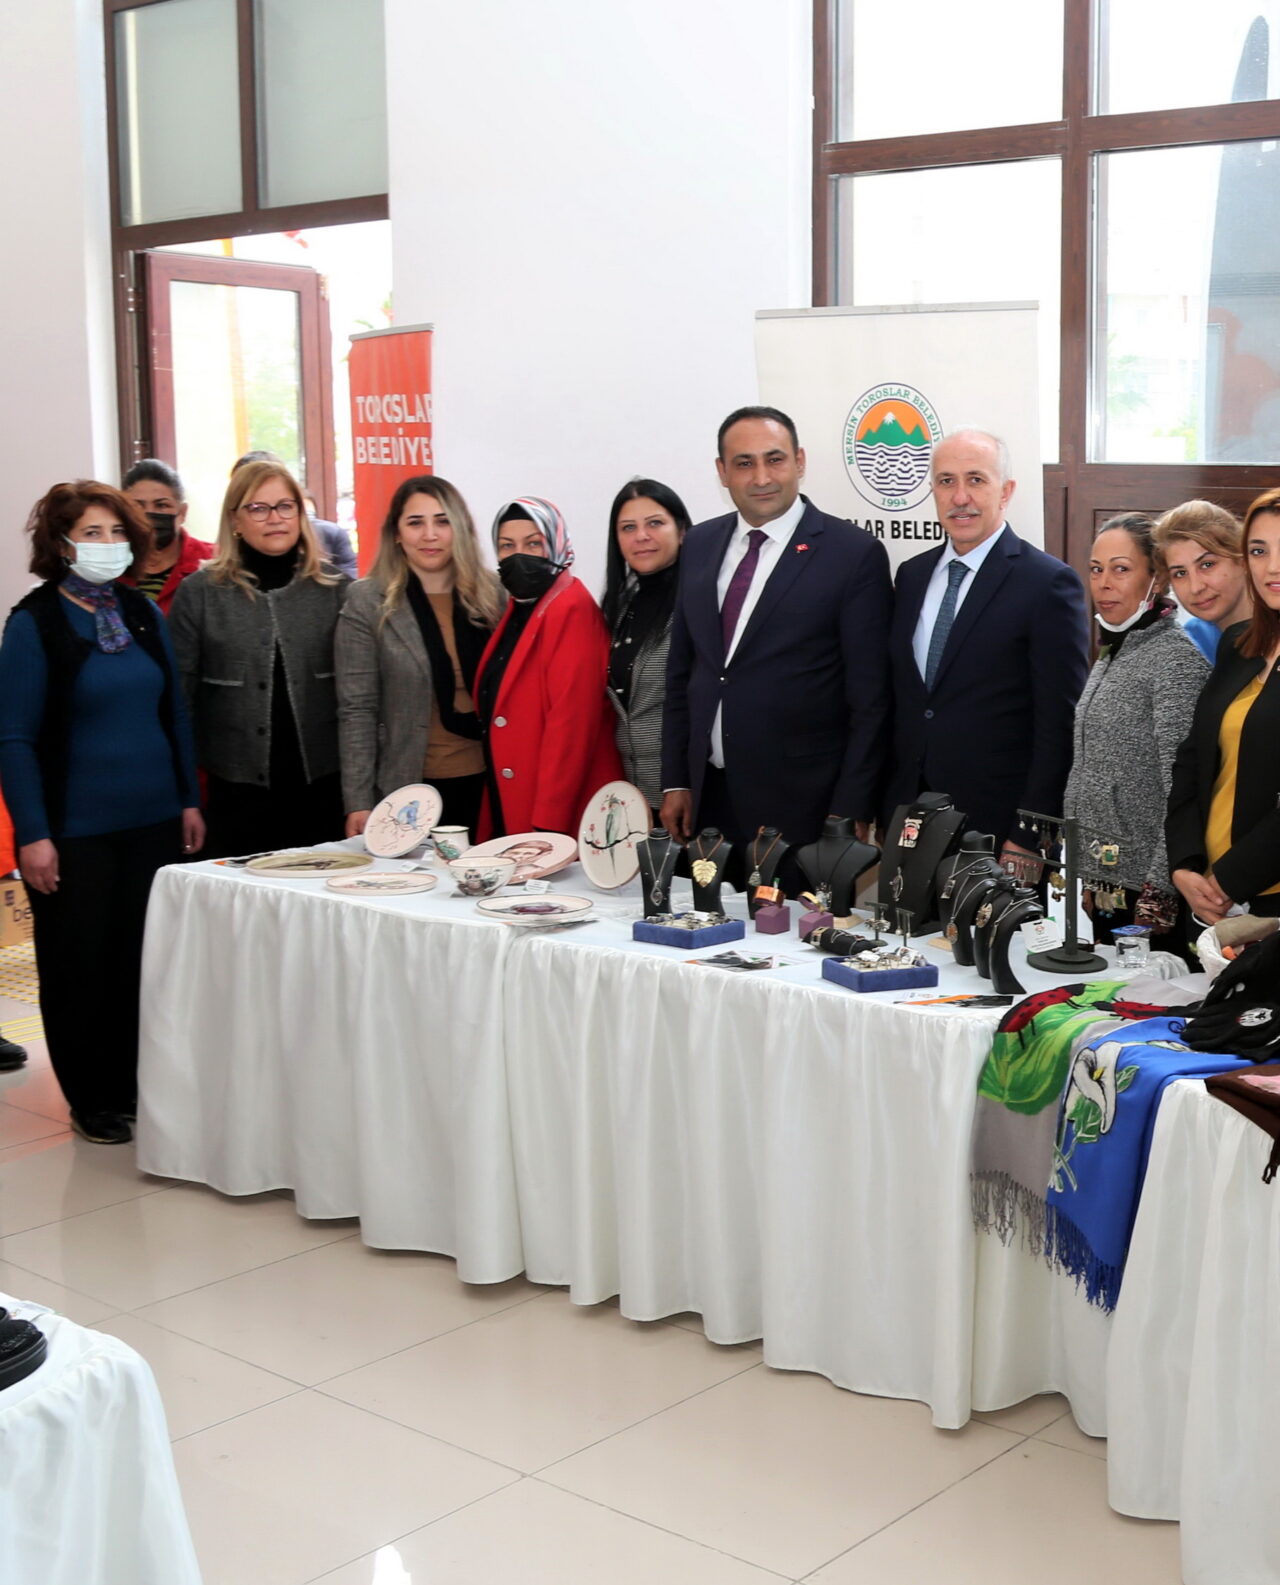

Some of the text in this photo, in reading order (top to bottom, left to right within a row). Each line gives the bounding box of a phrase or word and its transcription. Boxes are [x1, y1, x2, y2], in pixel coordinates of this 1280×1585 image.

[845, 415, 859, 465] MERSİN
[856, 387, 911, 414] TOROSLAR
[891, 520, 945, 540] BELED
